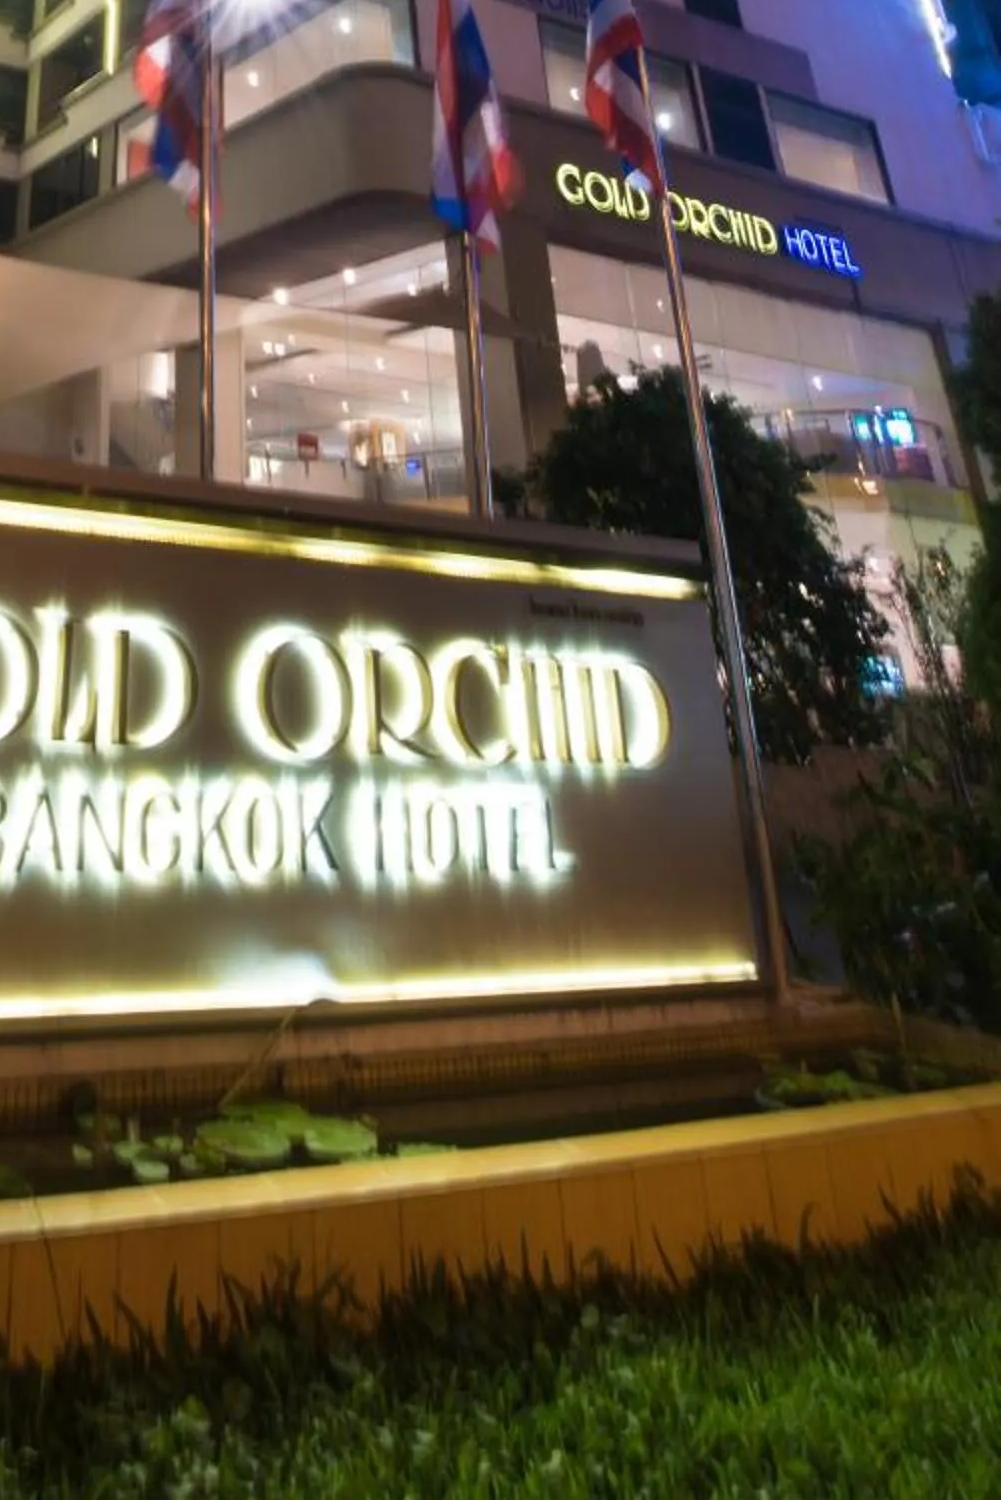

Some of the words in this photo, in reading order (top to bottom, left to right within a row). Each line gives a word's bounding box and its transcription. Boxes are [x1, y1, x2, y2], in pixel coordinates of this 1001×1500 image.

[556, 163, 650, 221] GOLD
[666, 190, 778, 255] ORCHID
[784, 226, 862, 275] HOTEL
[237, 625, 672, 770] ORCHID
[351, 782, 573, 882] HOTEL
